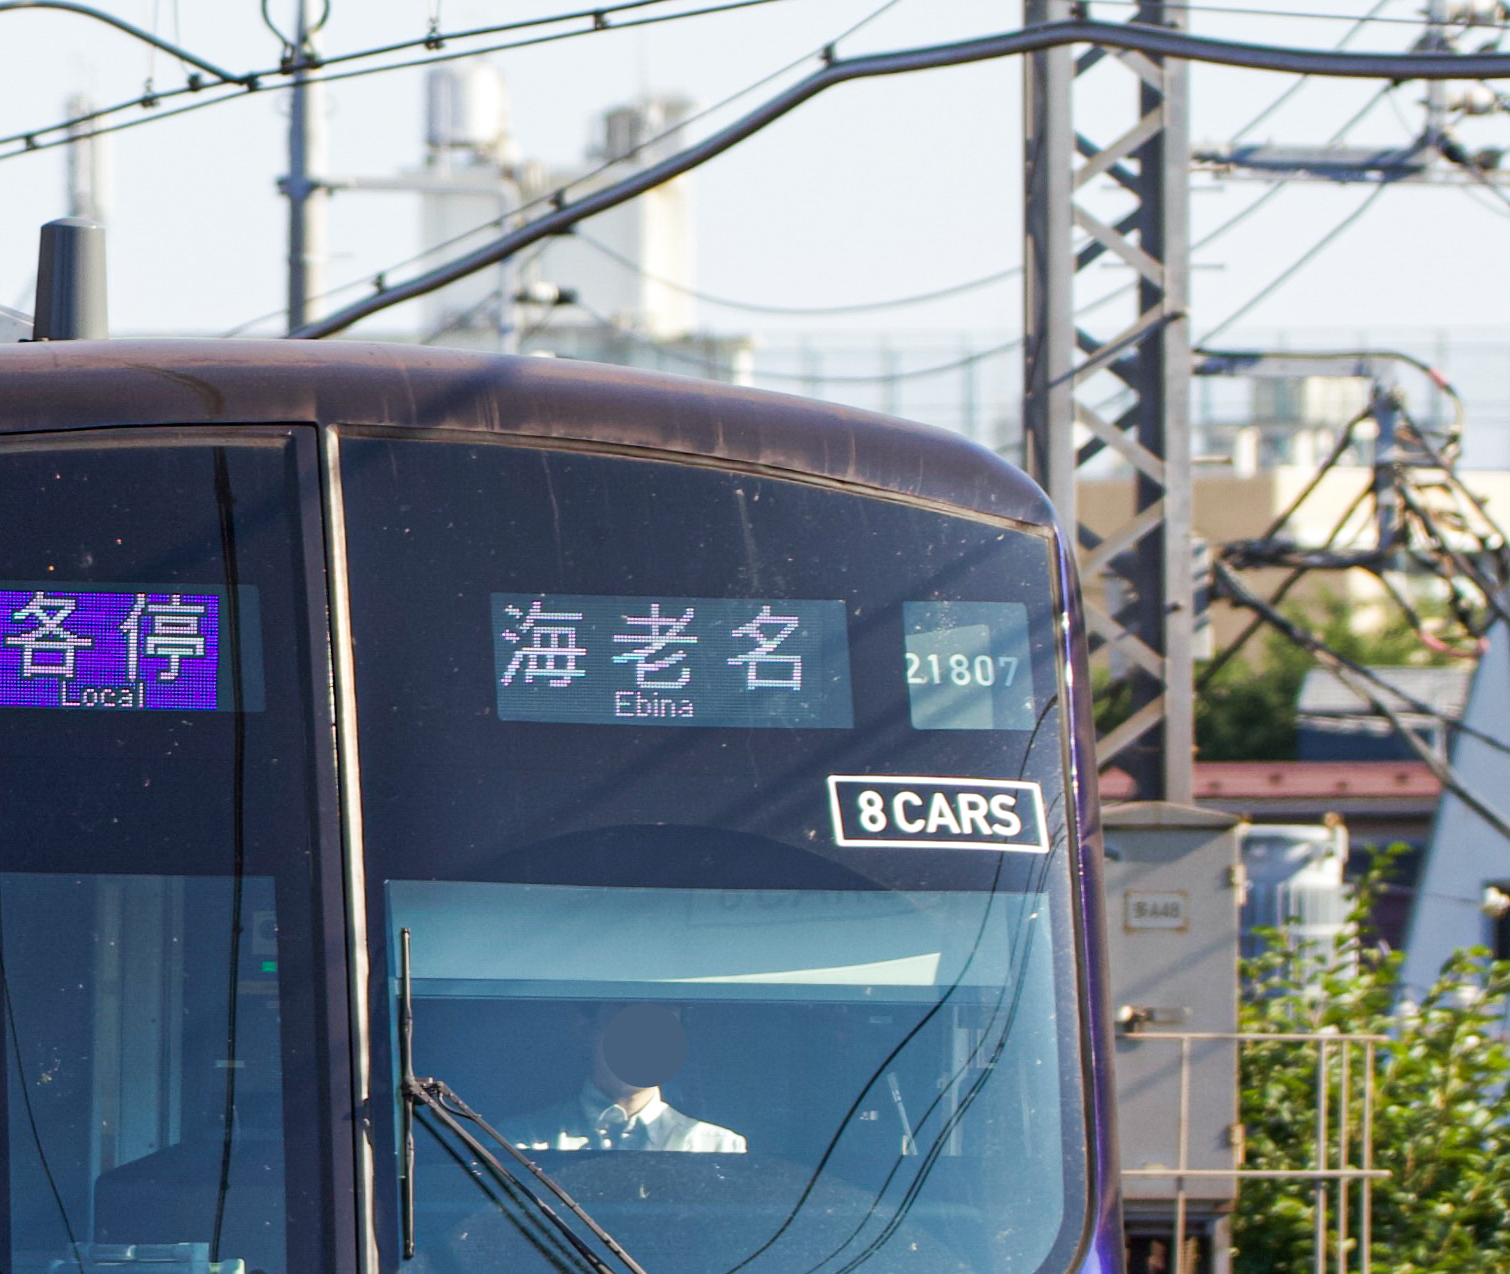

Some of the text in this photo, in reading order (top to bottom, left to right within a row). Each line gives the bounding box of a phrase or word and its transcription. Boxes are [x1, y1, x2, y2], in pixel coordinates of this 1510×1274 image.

[5, 591, 205, 681] 各停
[500, 601, 803, 692] 海老名
[904, 652, 1019, 687] 21807
[61, 680, 145, 709] Local
[614, 690, 694, 718] Ebina
